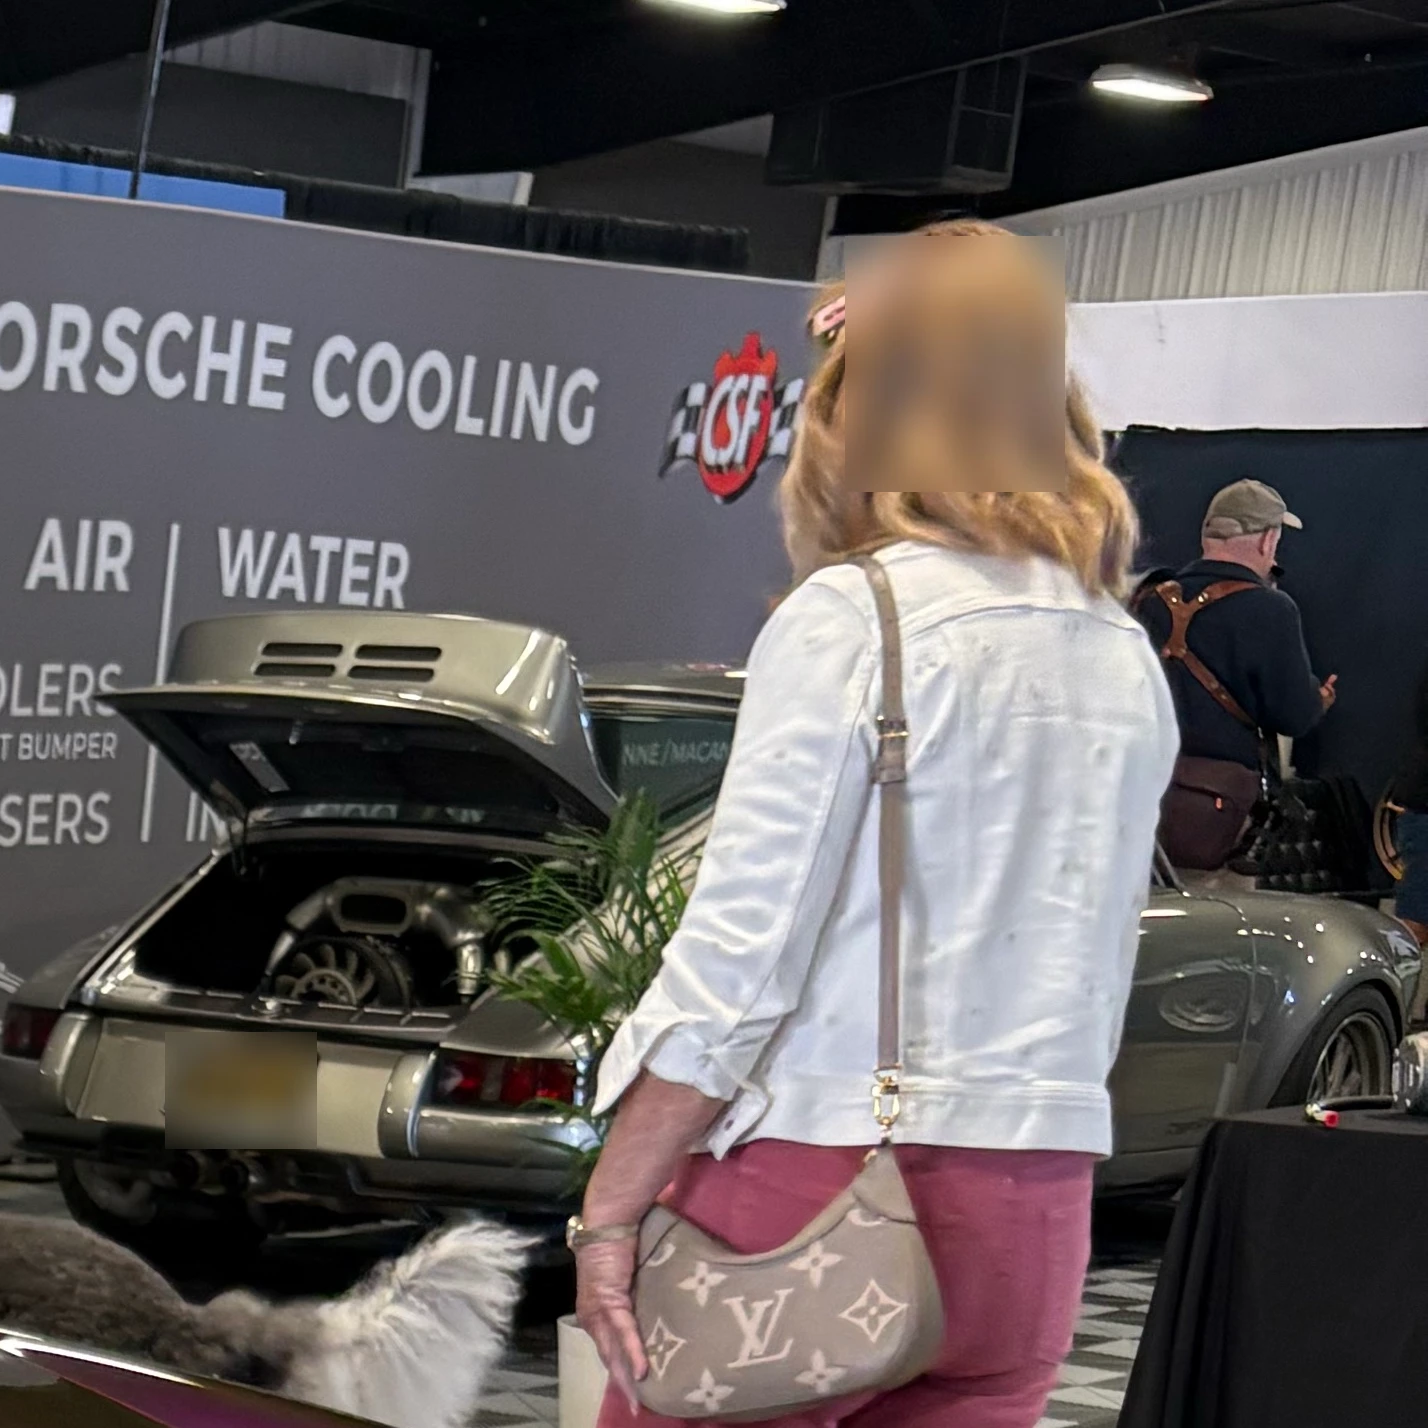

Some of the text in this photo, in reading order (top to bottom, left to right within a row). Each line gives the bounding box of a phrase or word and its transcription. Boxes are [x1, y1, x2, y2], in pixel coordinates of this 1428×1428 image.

[311, 334, 601, 447] COOLING
[701, 373, 768, 468] CSF
[23, 517, 412, 610] AIR WATER
[17, 731, 118, 761] BUMPER
